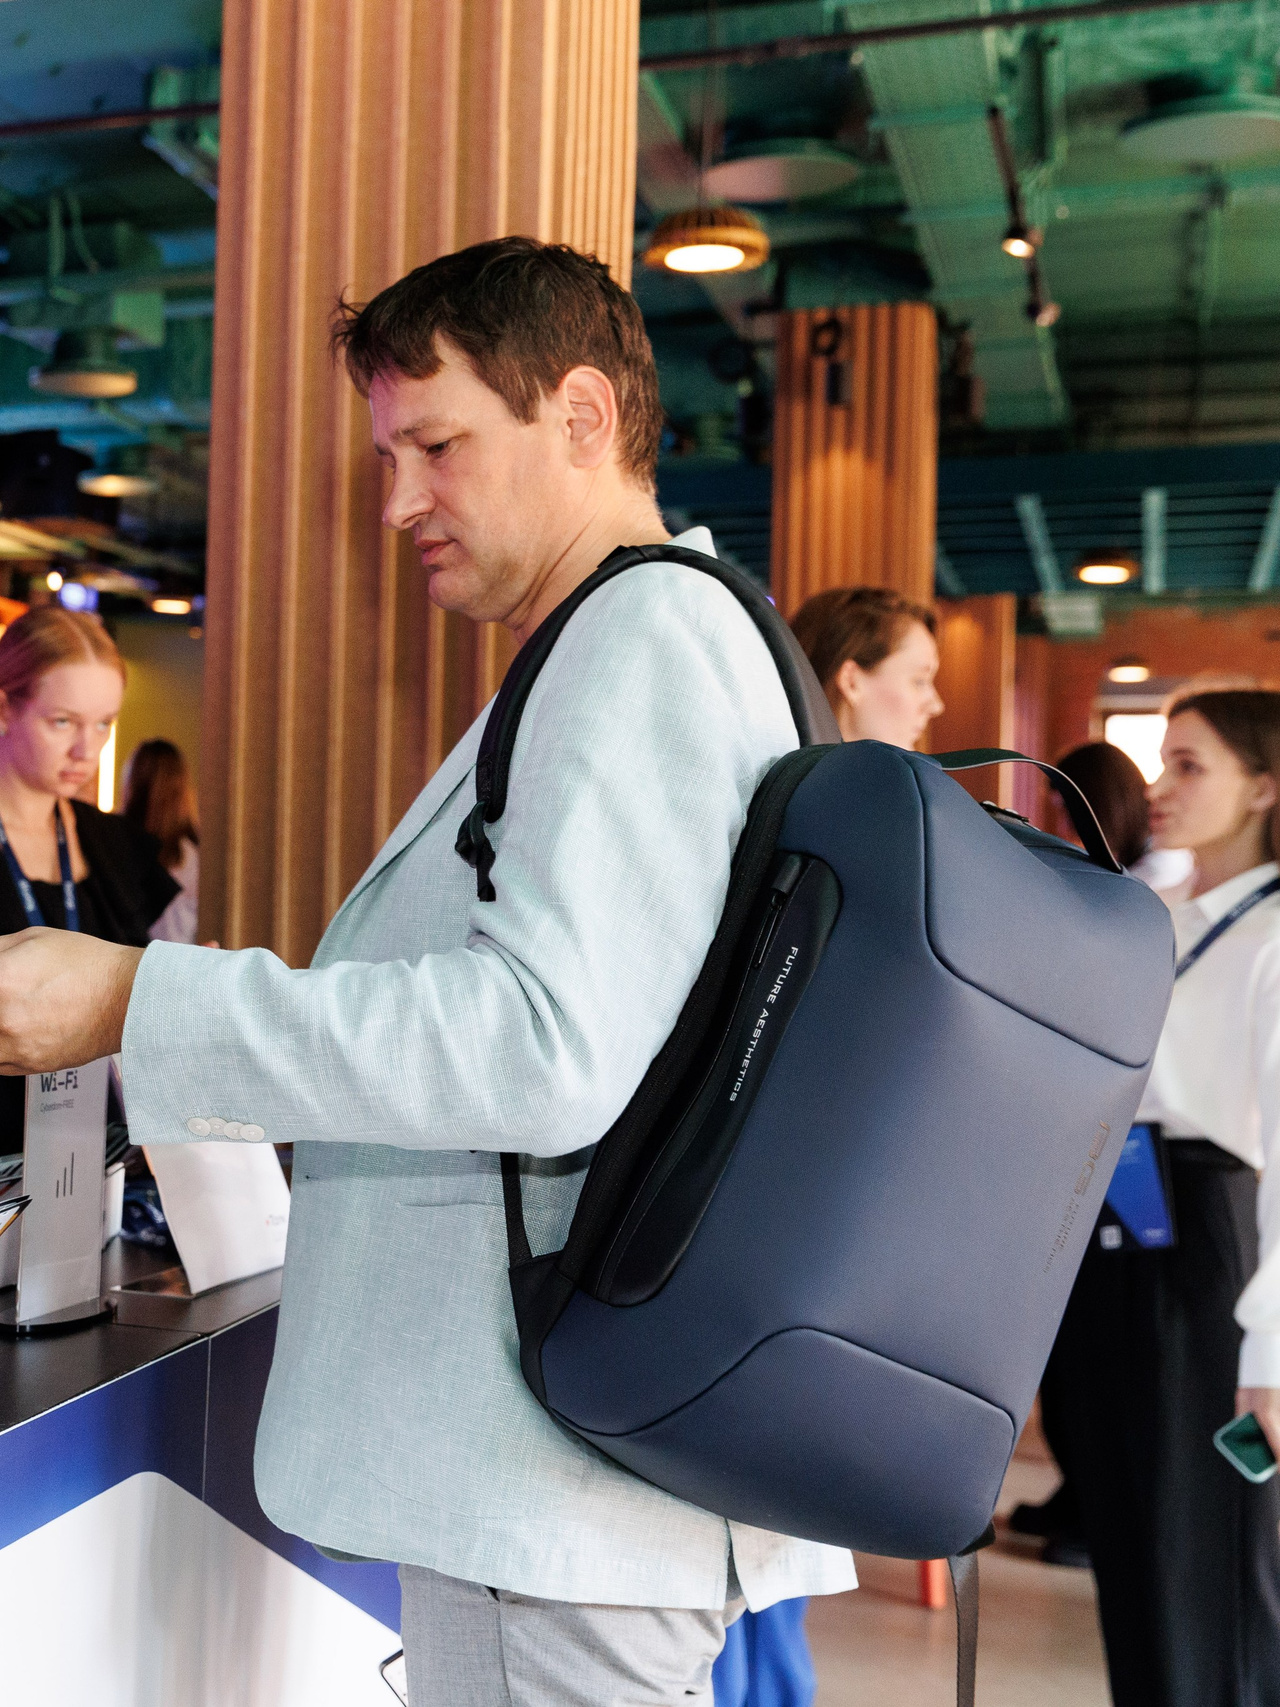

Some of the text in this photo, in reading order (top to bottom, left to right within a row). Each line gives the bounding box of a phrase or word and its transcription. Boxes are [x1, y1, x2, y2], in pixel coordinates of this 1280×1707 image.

[729, 946, 799, 1102] FUTURE AESTHETICS
[40, 1069, 78, 1093] Wi-Fi
